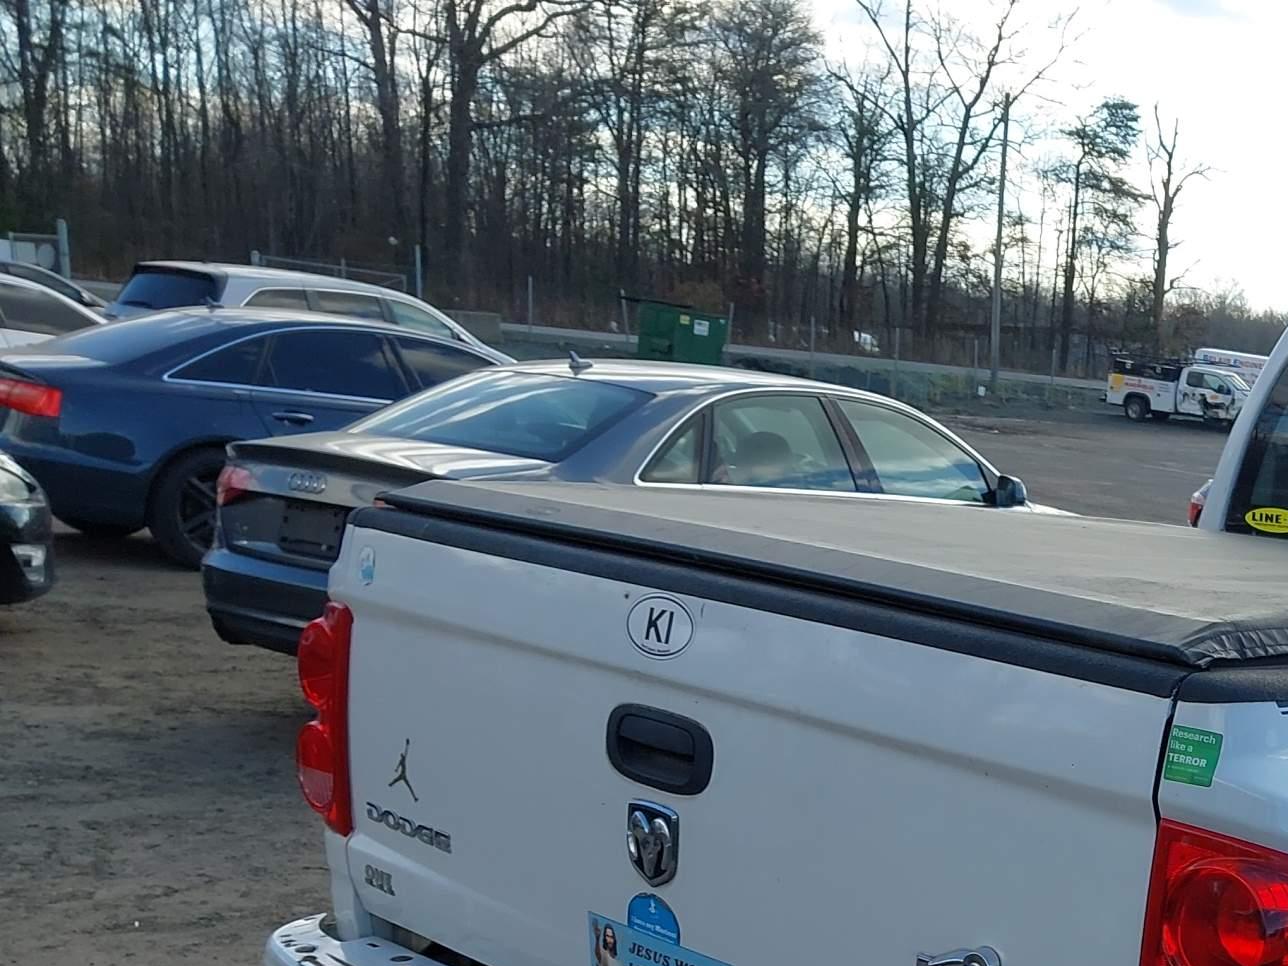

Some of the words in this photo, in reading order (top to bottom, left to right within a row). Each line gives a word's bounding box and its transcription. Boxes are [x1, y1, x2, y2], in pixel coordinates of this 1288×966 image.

[645, 607, 675, 645] KI
[1169, 739, 1186, 752] like
[1171, 727, 1217, 746] Research
[1168, 752, 1208, 768] TERROR
[366, 801, 453, 854] DODGE
